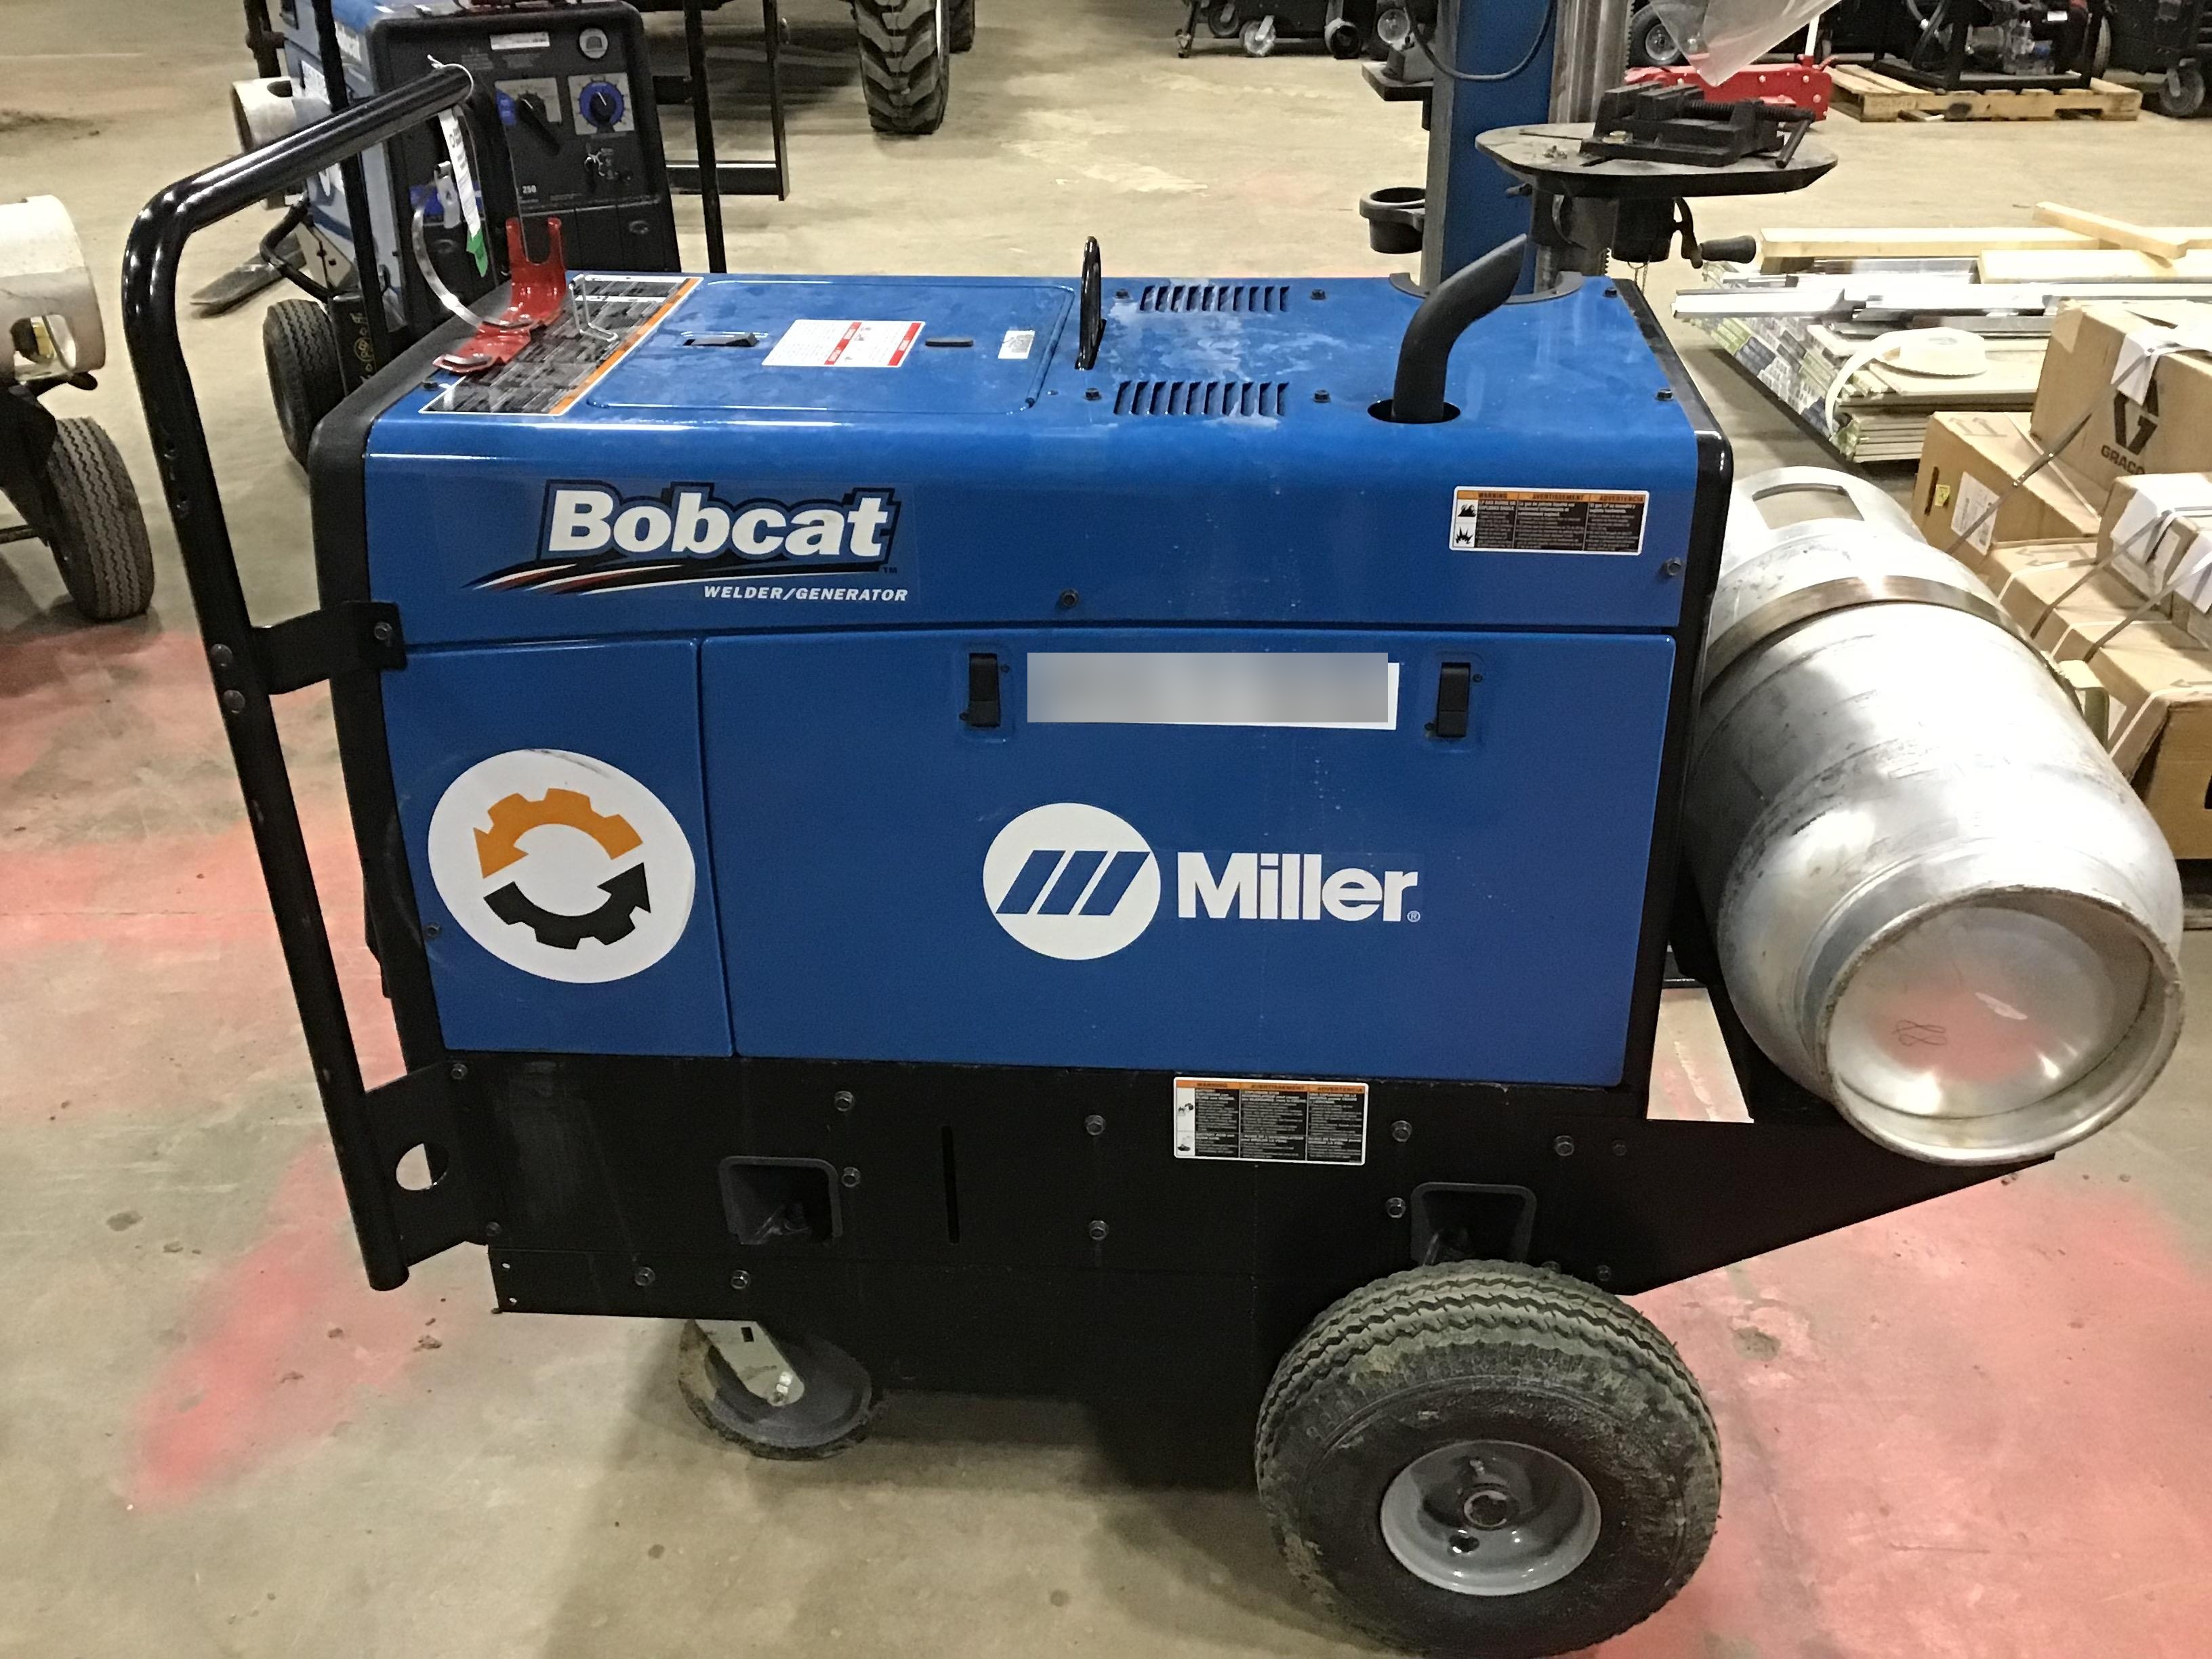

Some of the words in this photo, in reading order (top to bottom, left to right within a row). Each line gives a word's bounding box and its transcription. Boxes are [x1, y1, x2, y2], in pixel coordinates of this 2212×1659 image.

[549, 490, 888, 557] Bobcat
[703, 586, 908, 602] WELDER/GENERATOR
[1177, 852, 1418, 922] Miller
